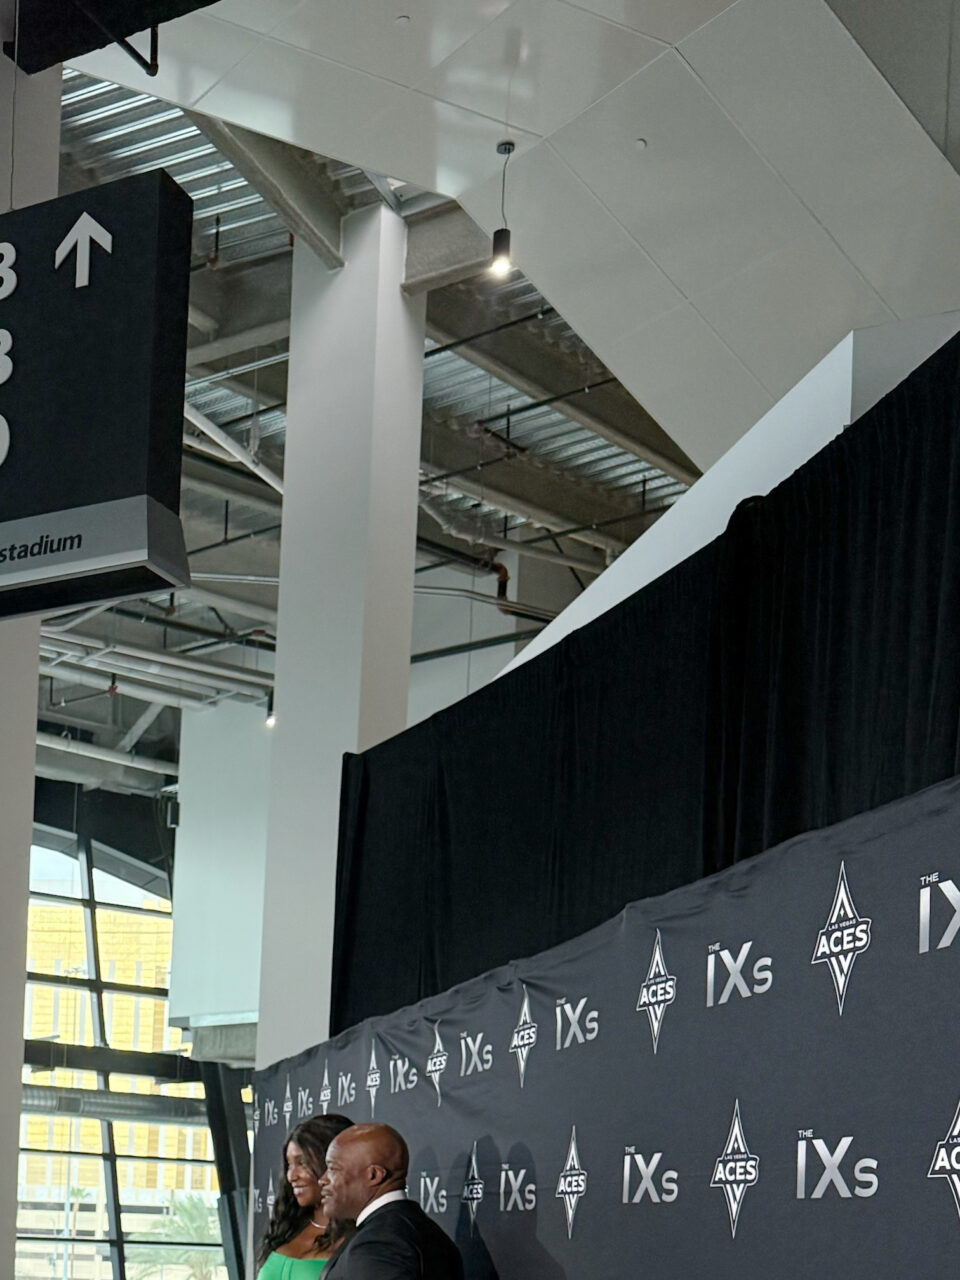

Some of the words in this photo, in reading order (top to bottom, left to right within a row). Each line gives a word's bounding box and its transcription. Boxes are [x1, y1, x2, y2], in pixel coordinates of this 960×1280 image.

[920, 872, 939, 885] THE
[817, 924, 867, 957] ACES
[706, 941, 773, 1008] IXs
[640, 981, 674, 1005] ACES
[511, 1027, 536, 1048] ACES
[555, 997, 599, 1051] IXs
[460, 1032, 493, 1077] IXs
[798, 1129, 813, 1137] THE
[559, 1175, 585, 1192] ACES
[623, 1153, 678, 1204] IXs
[715, 1160, 756, 1181] ACES
[796, 1136, 879, 1199] IXs
[420, 1177, 447, 1213] IXs
[500, 1169, 536, 1211] IXs
